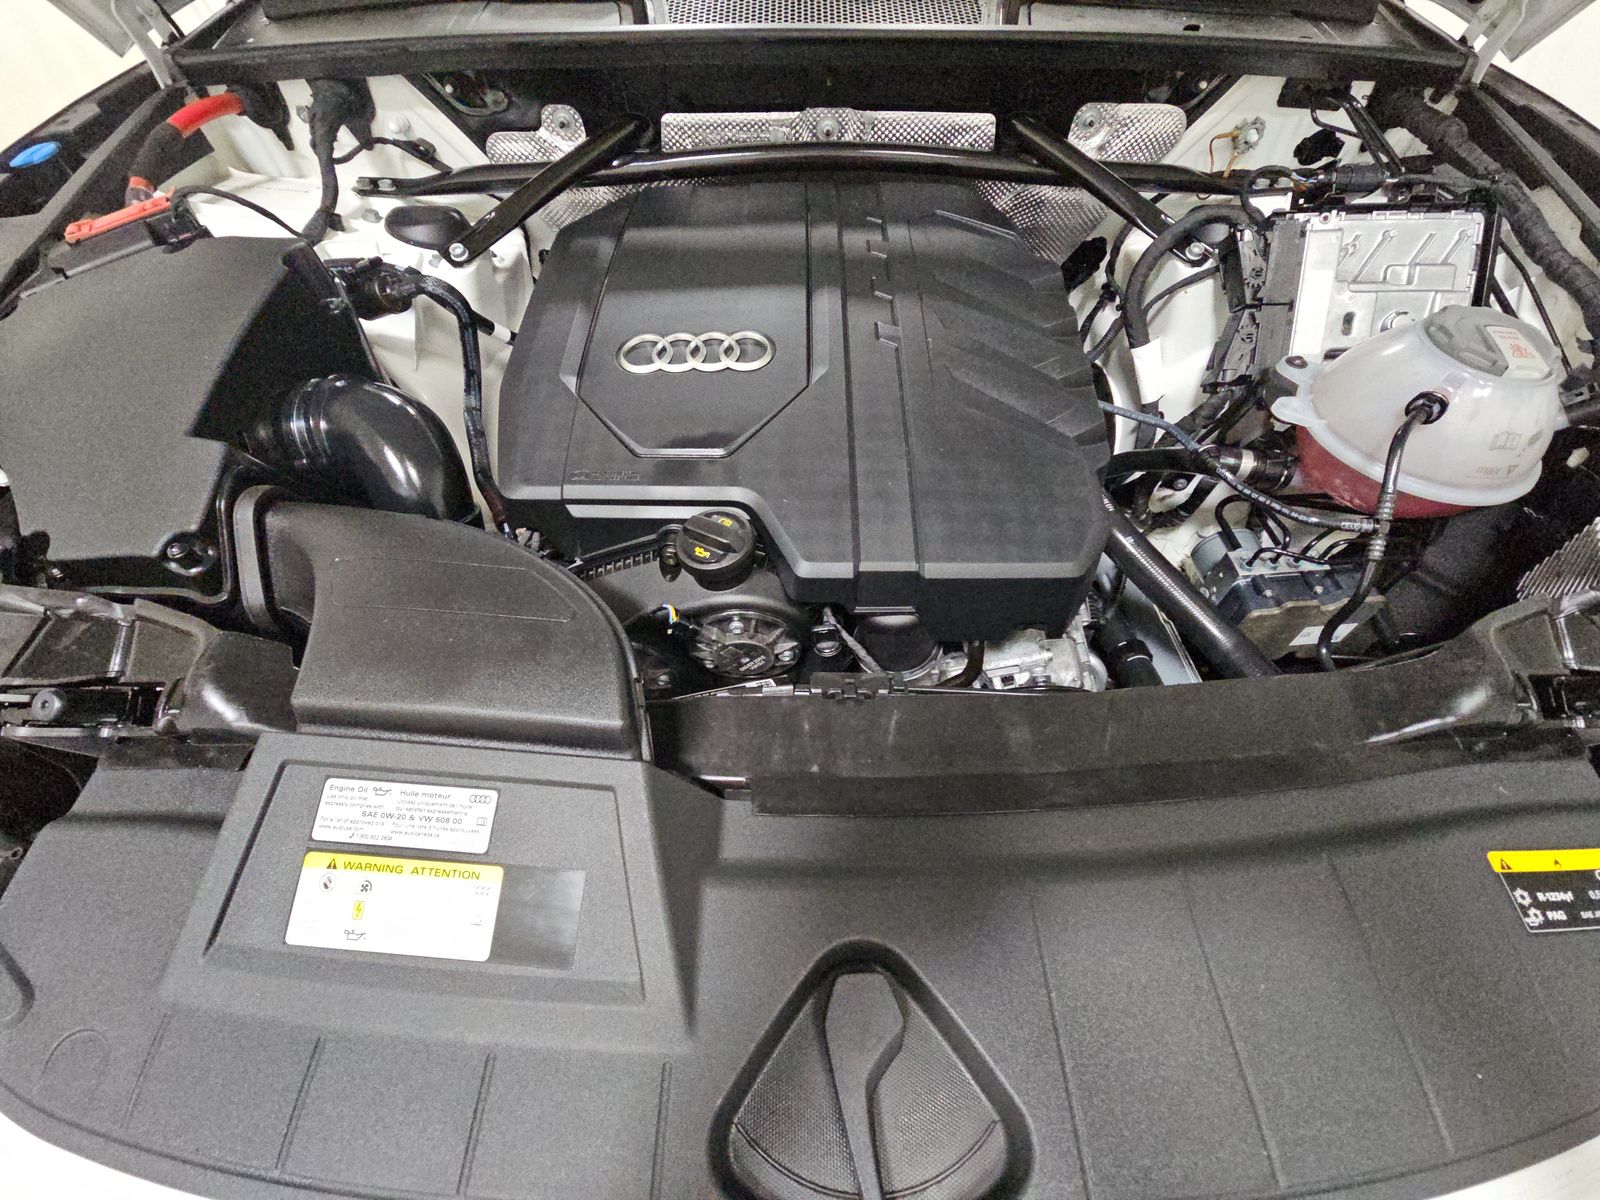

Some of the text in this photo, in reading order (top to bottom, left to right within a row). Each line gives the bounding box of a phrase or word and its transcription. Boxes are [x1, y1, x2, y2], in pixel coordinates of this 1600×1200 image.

[330, 784, 355, 792] Engine
[380, 812, 407, 820] 0W-20
[343, 861, 481, 880] WARNING ATTENTION
[1546, 910, 1567, 921] PAG
